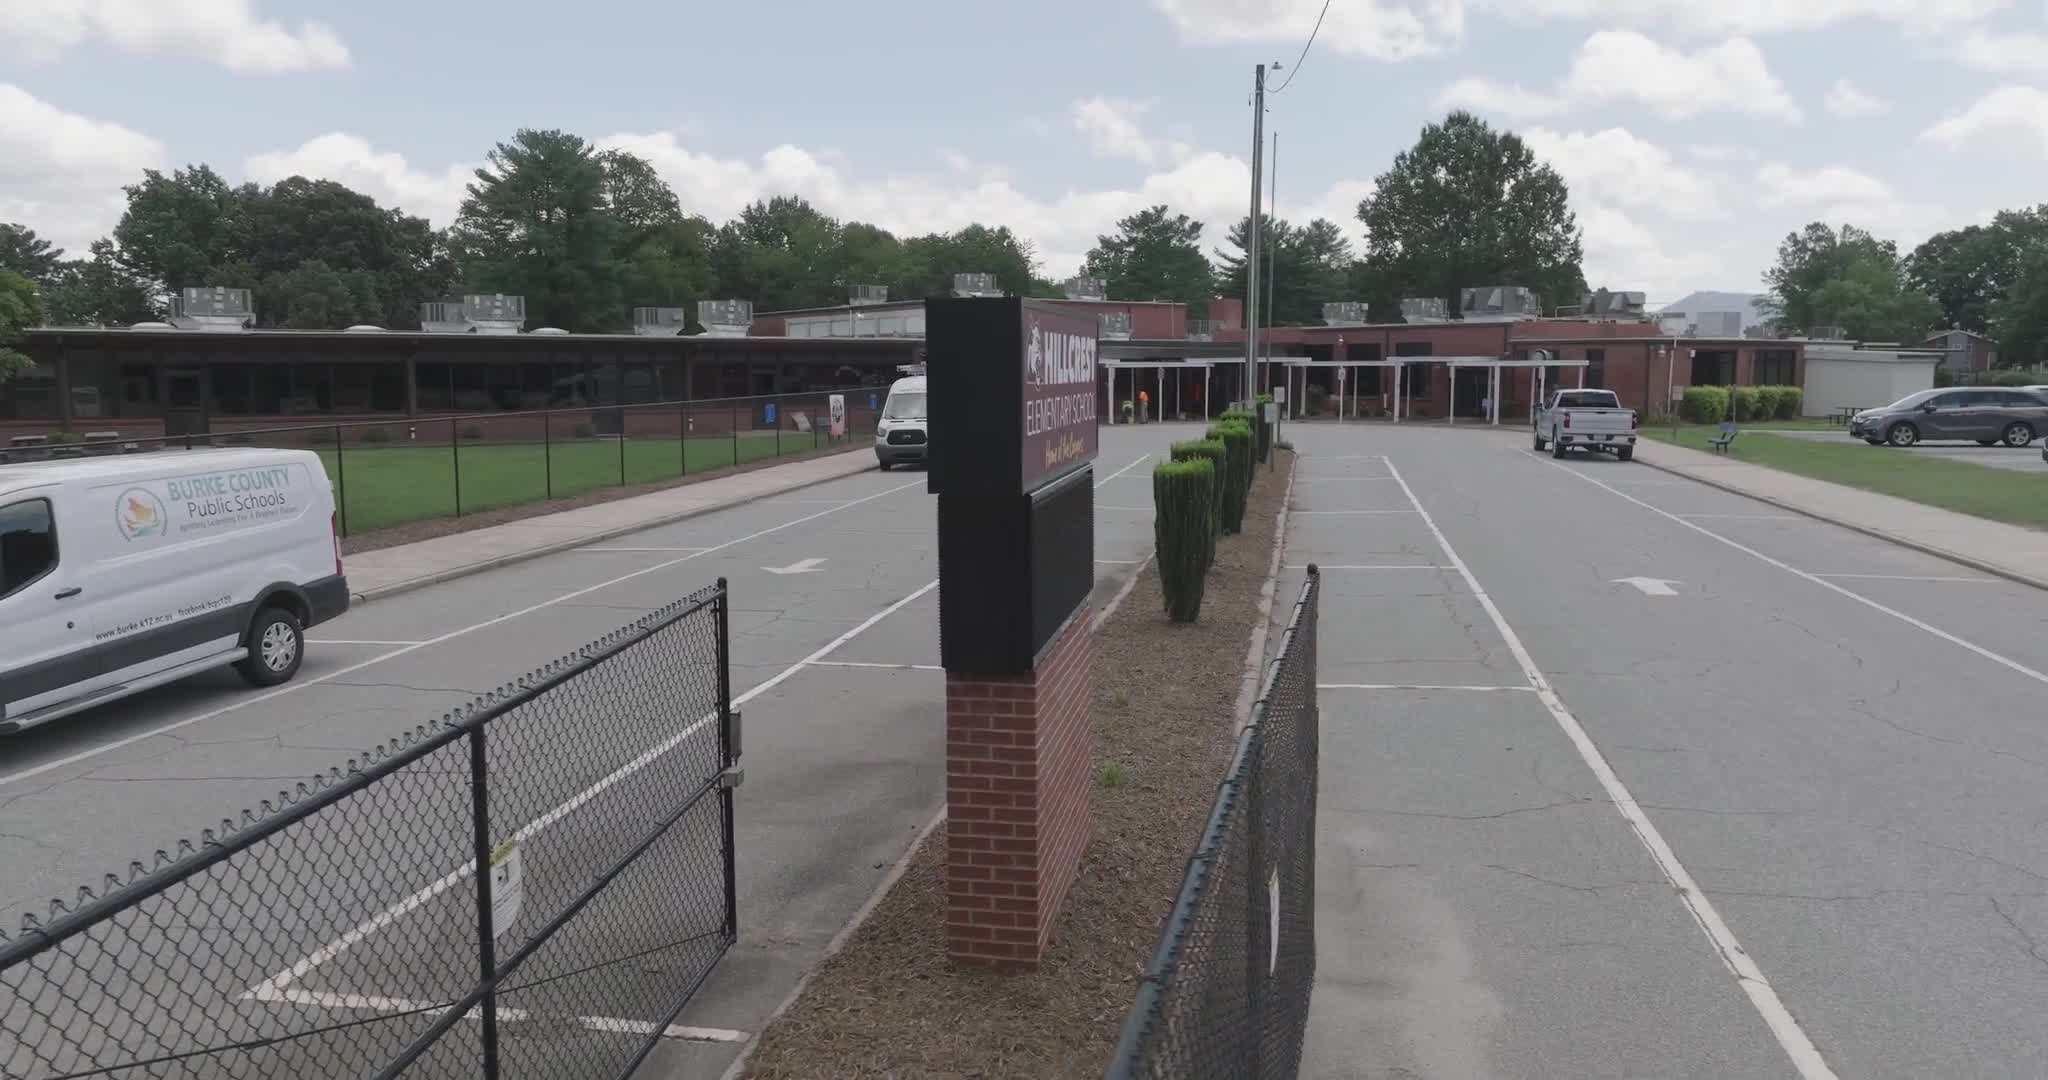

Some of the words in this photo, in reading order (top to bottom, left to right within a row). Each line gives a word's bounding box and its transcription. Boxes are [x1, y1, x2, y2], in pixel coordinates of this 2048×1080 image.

[1044, 331, 1096, 385] HILLCREST
[1027, 396, 1073, 436] ELEMENTARY
[1072, 391, 1096, 424] SCHOOL
[167, 477, 226, 501] BURKE
[228, 468, 289, 493] COUNTY
[187, 497, 233, 518] Public
[235, 490, 286, 512] Schools
